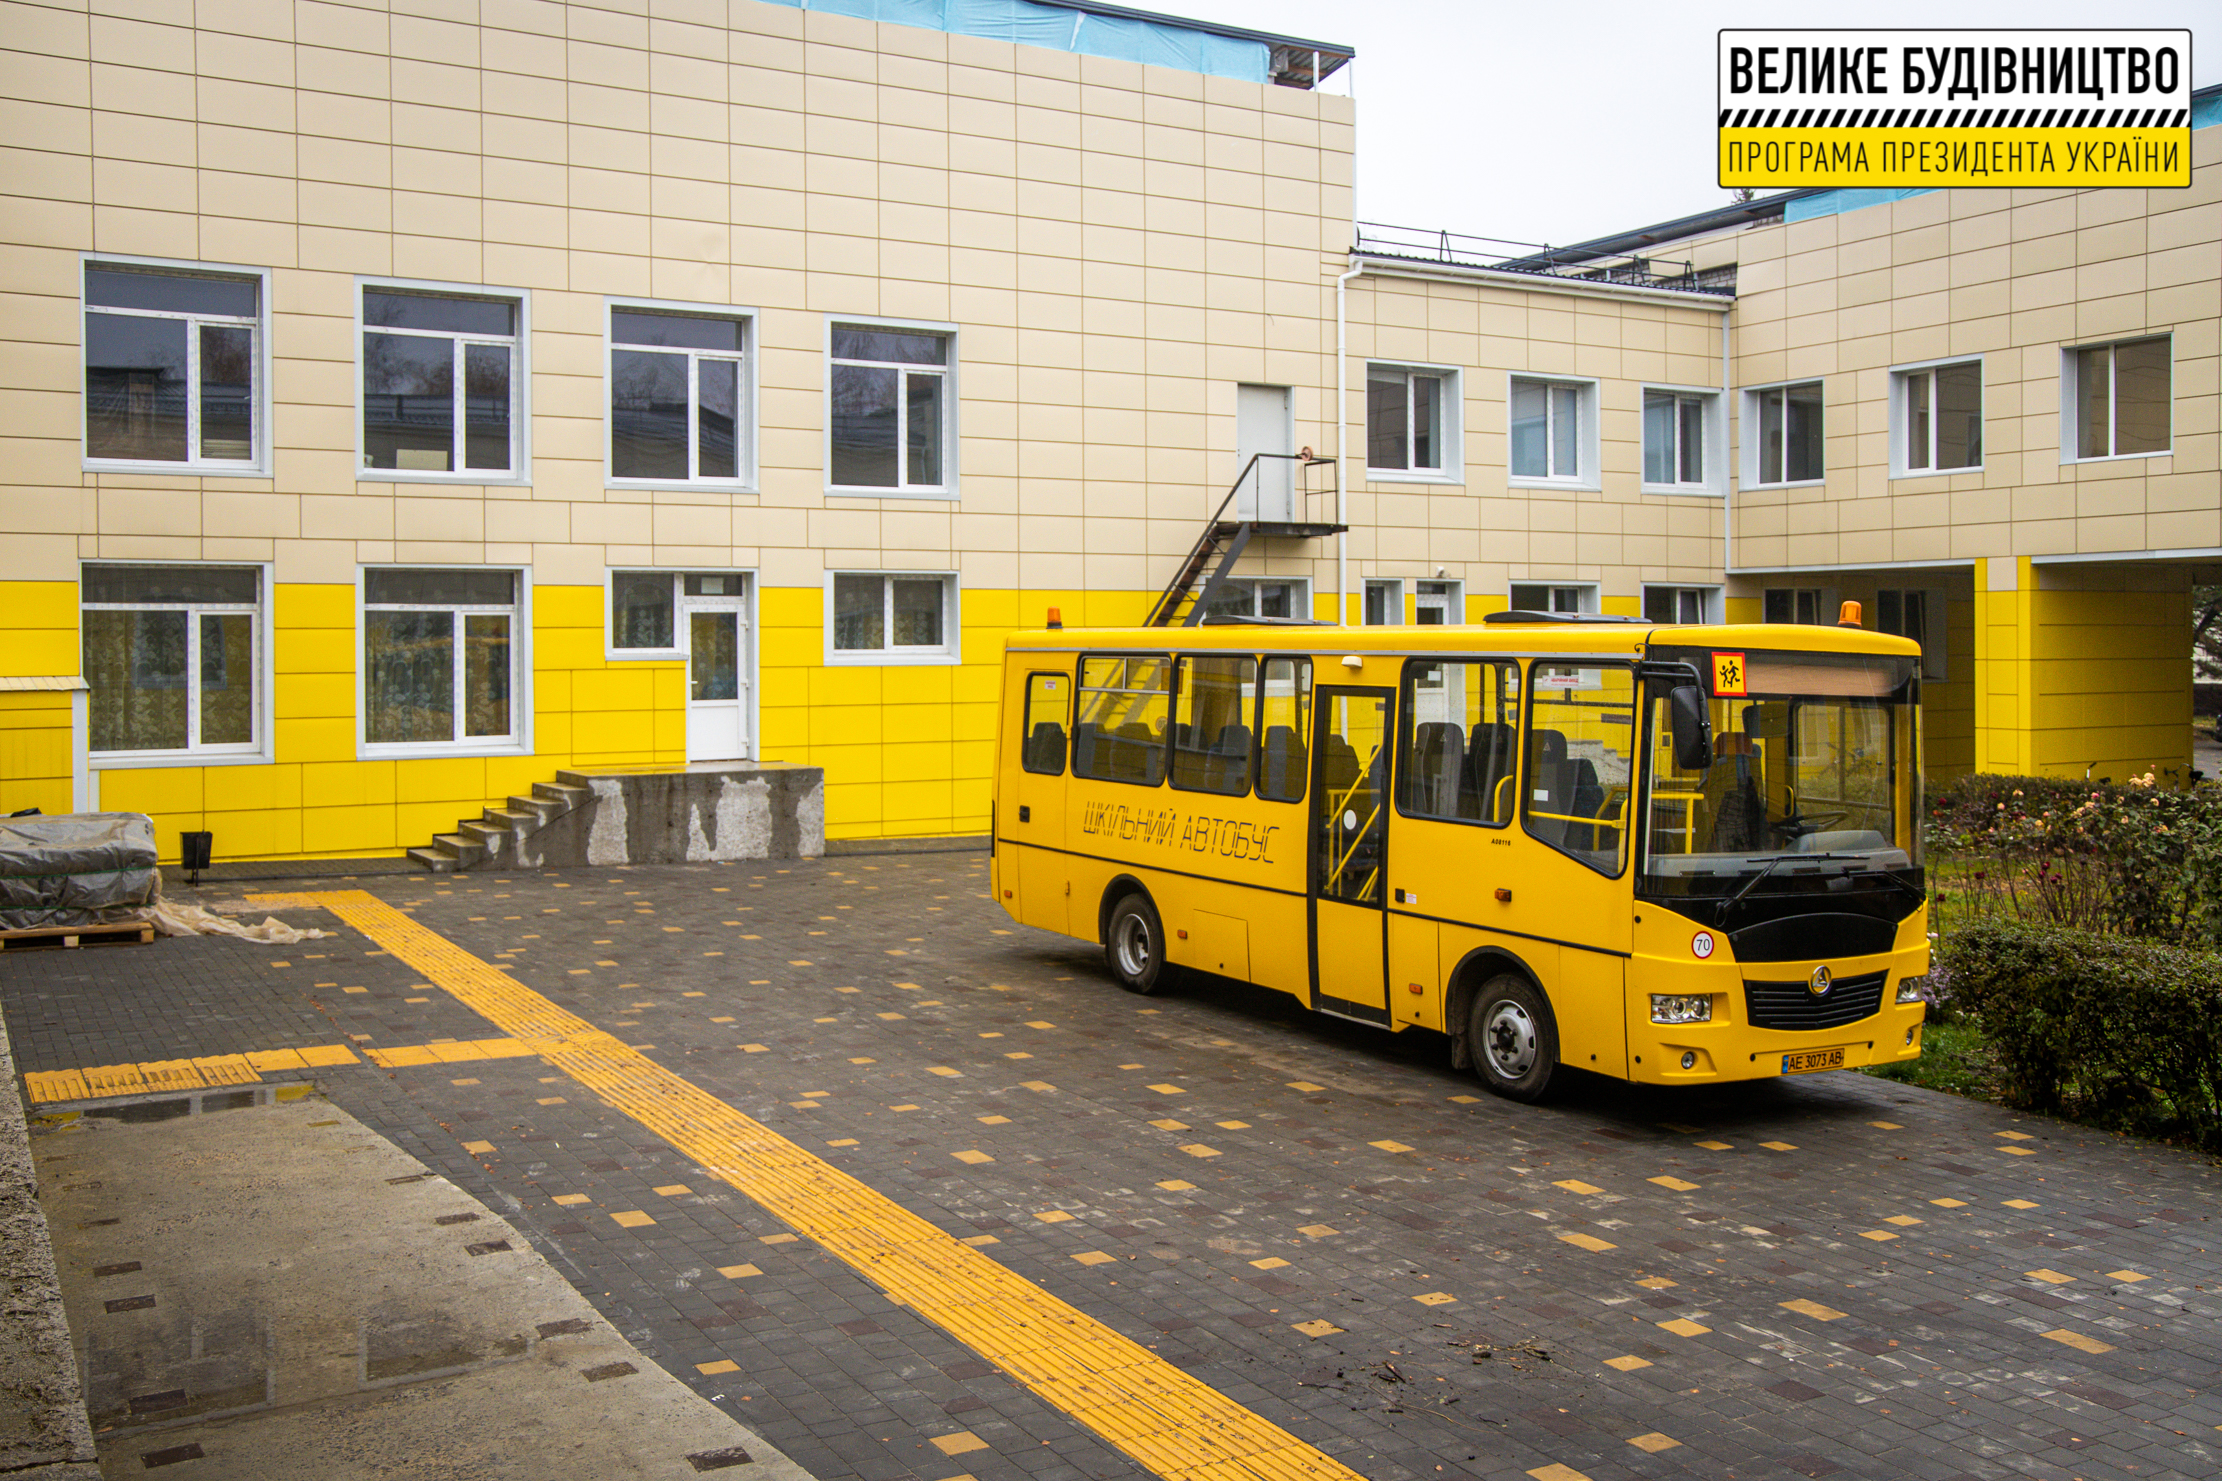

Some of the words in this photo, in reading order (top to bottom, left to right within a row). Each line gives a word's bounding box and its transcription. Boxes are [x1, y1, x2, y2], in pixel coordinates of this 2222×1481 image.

[1083, 801, 1176, 847] ШКІЛЬНИЙ
[1180, 815, 1280, 864] АВТОБУС
[1696, 938, 1710, 951] 70
[1805, 1053, 1827, 1068] 3073
